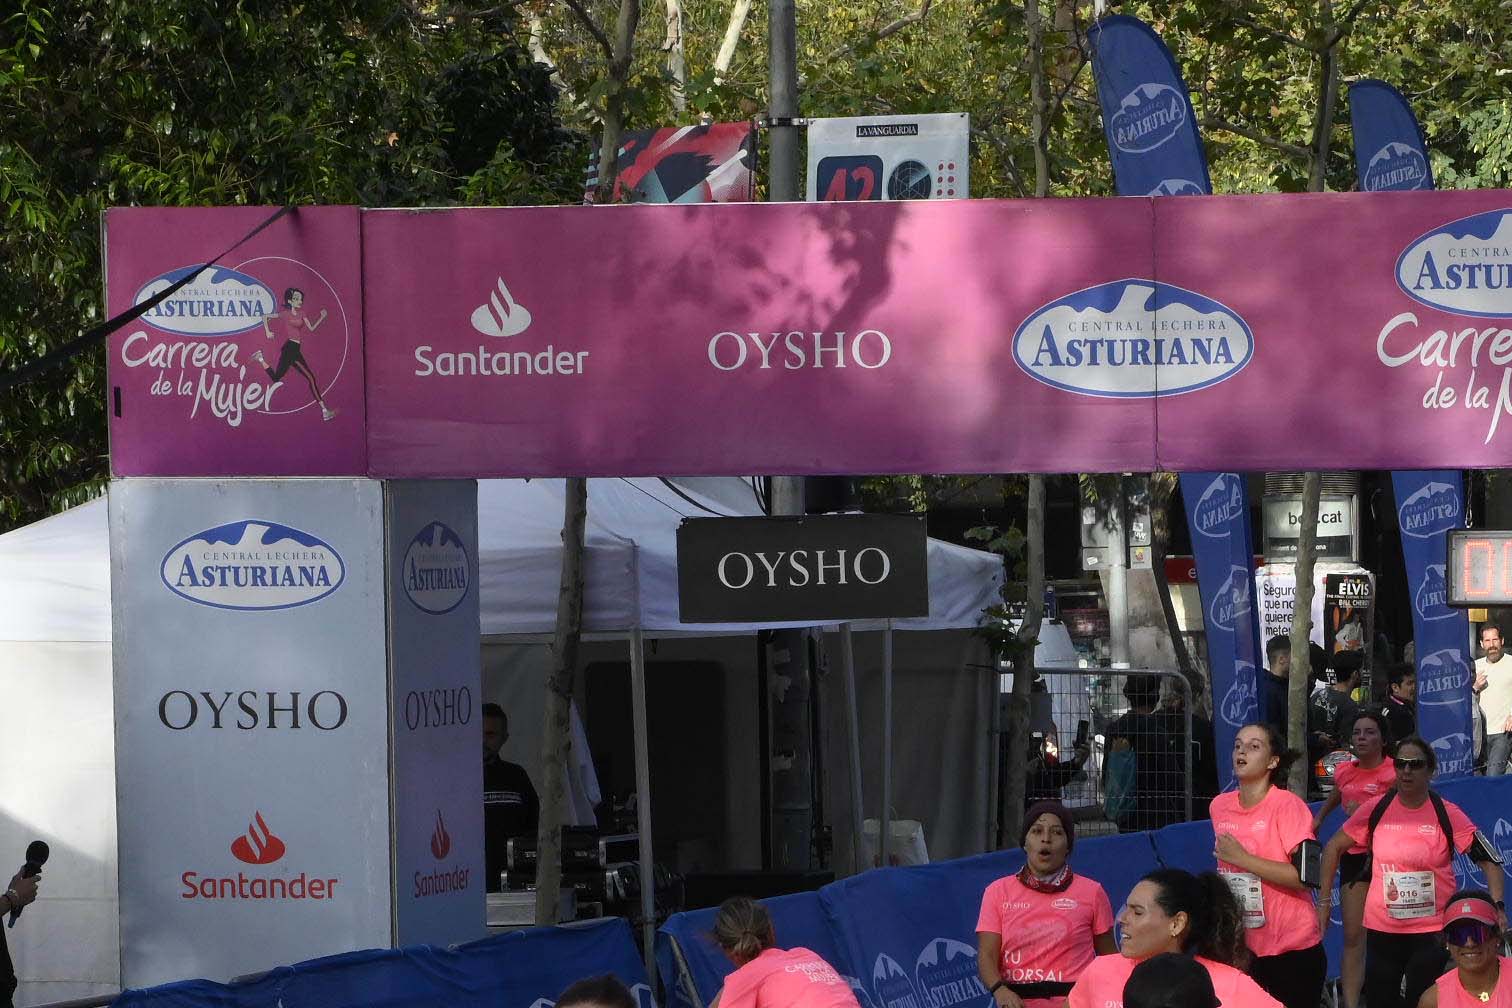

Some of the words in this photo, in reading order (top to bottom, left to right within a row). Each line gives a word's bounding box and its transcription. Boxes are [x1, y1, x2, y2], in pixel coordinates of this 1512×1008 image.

[1068, 320, 1144, 333] CENTRAL
[1151, 320, 1227, 332] LECHERA
[121, 331, 239, 369] Carrera
[414, 345, 589, 376] Santander
[708, 330, 892, 371] OYSHO
[1031, 324, 1236, 367] ASTURIANA
[150, 371, 172, 396] de
[178, 370, 192, 396] la
[191, 365, 284, 427] Mujer
[1422, 371, 1457, 409] de
[1464, 371, 1490, 409] la
[176, 554, 332, 588] ASTURIANA
[203, 551, 262, 561] CENTRAL
[267, 551, 325, 561] LECHERA
[408, 556, 466, 592] ASTURIANA
[717, 547, 891, 589] OYSHO
[1264, 600, 1281, 612] que
[1338, 583, 1370, 596] ELVIS
[158, 690, 348, 731] OYSHO
[405, 686, 472, 731] OYSHO
[181, 871, 338, 900] Santander
[414, 867, 469, 899] Santander
